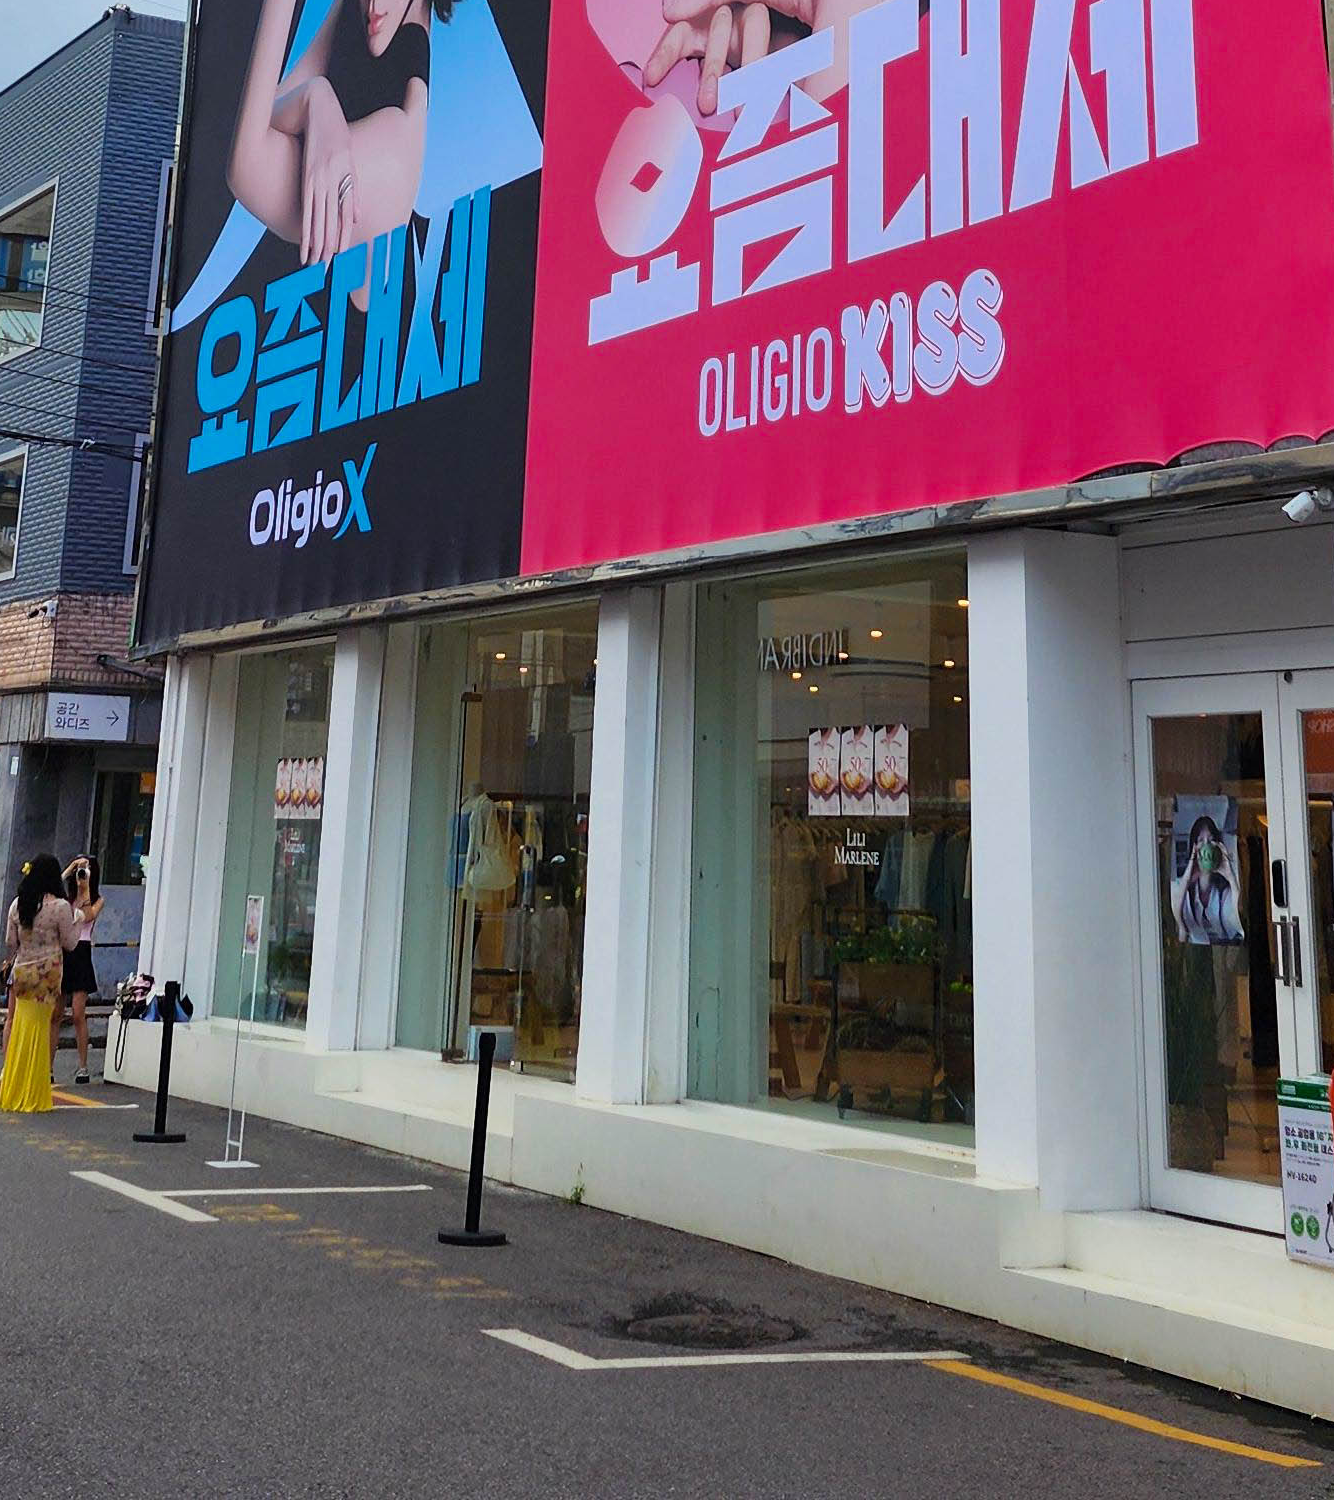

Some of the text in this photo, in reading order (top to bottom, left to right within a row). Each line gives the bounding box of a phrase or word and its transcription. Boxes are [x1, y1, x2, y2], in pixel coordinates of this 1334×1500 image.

[187, 183, 493, 474] 요즘대세
[697, 267, 1007, 437] OLIGIO KISS
[56, 701, 79, 716] 공간
[54, 716, 90, 731] 와디즈
[834, 845, 880, 867] MARLENE
